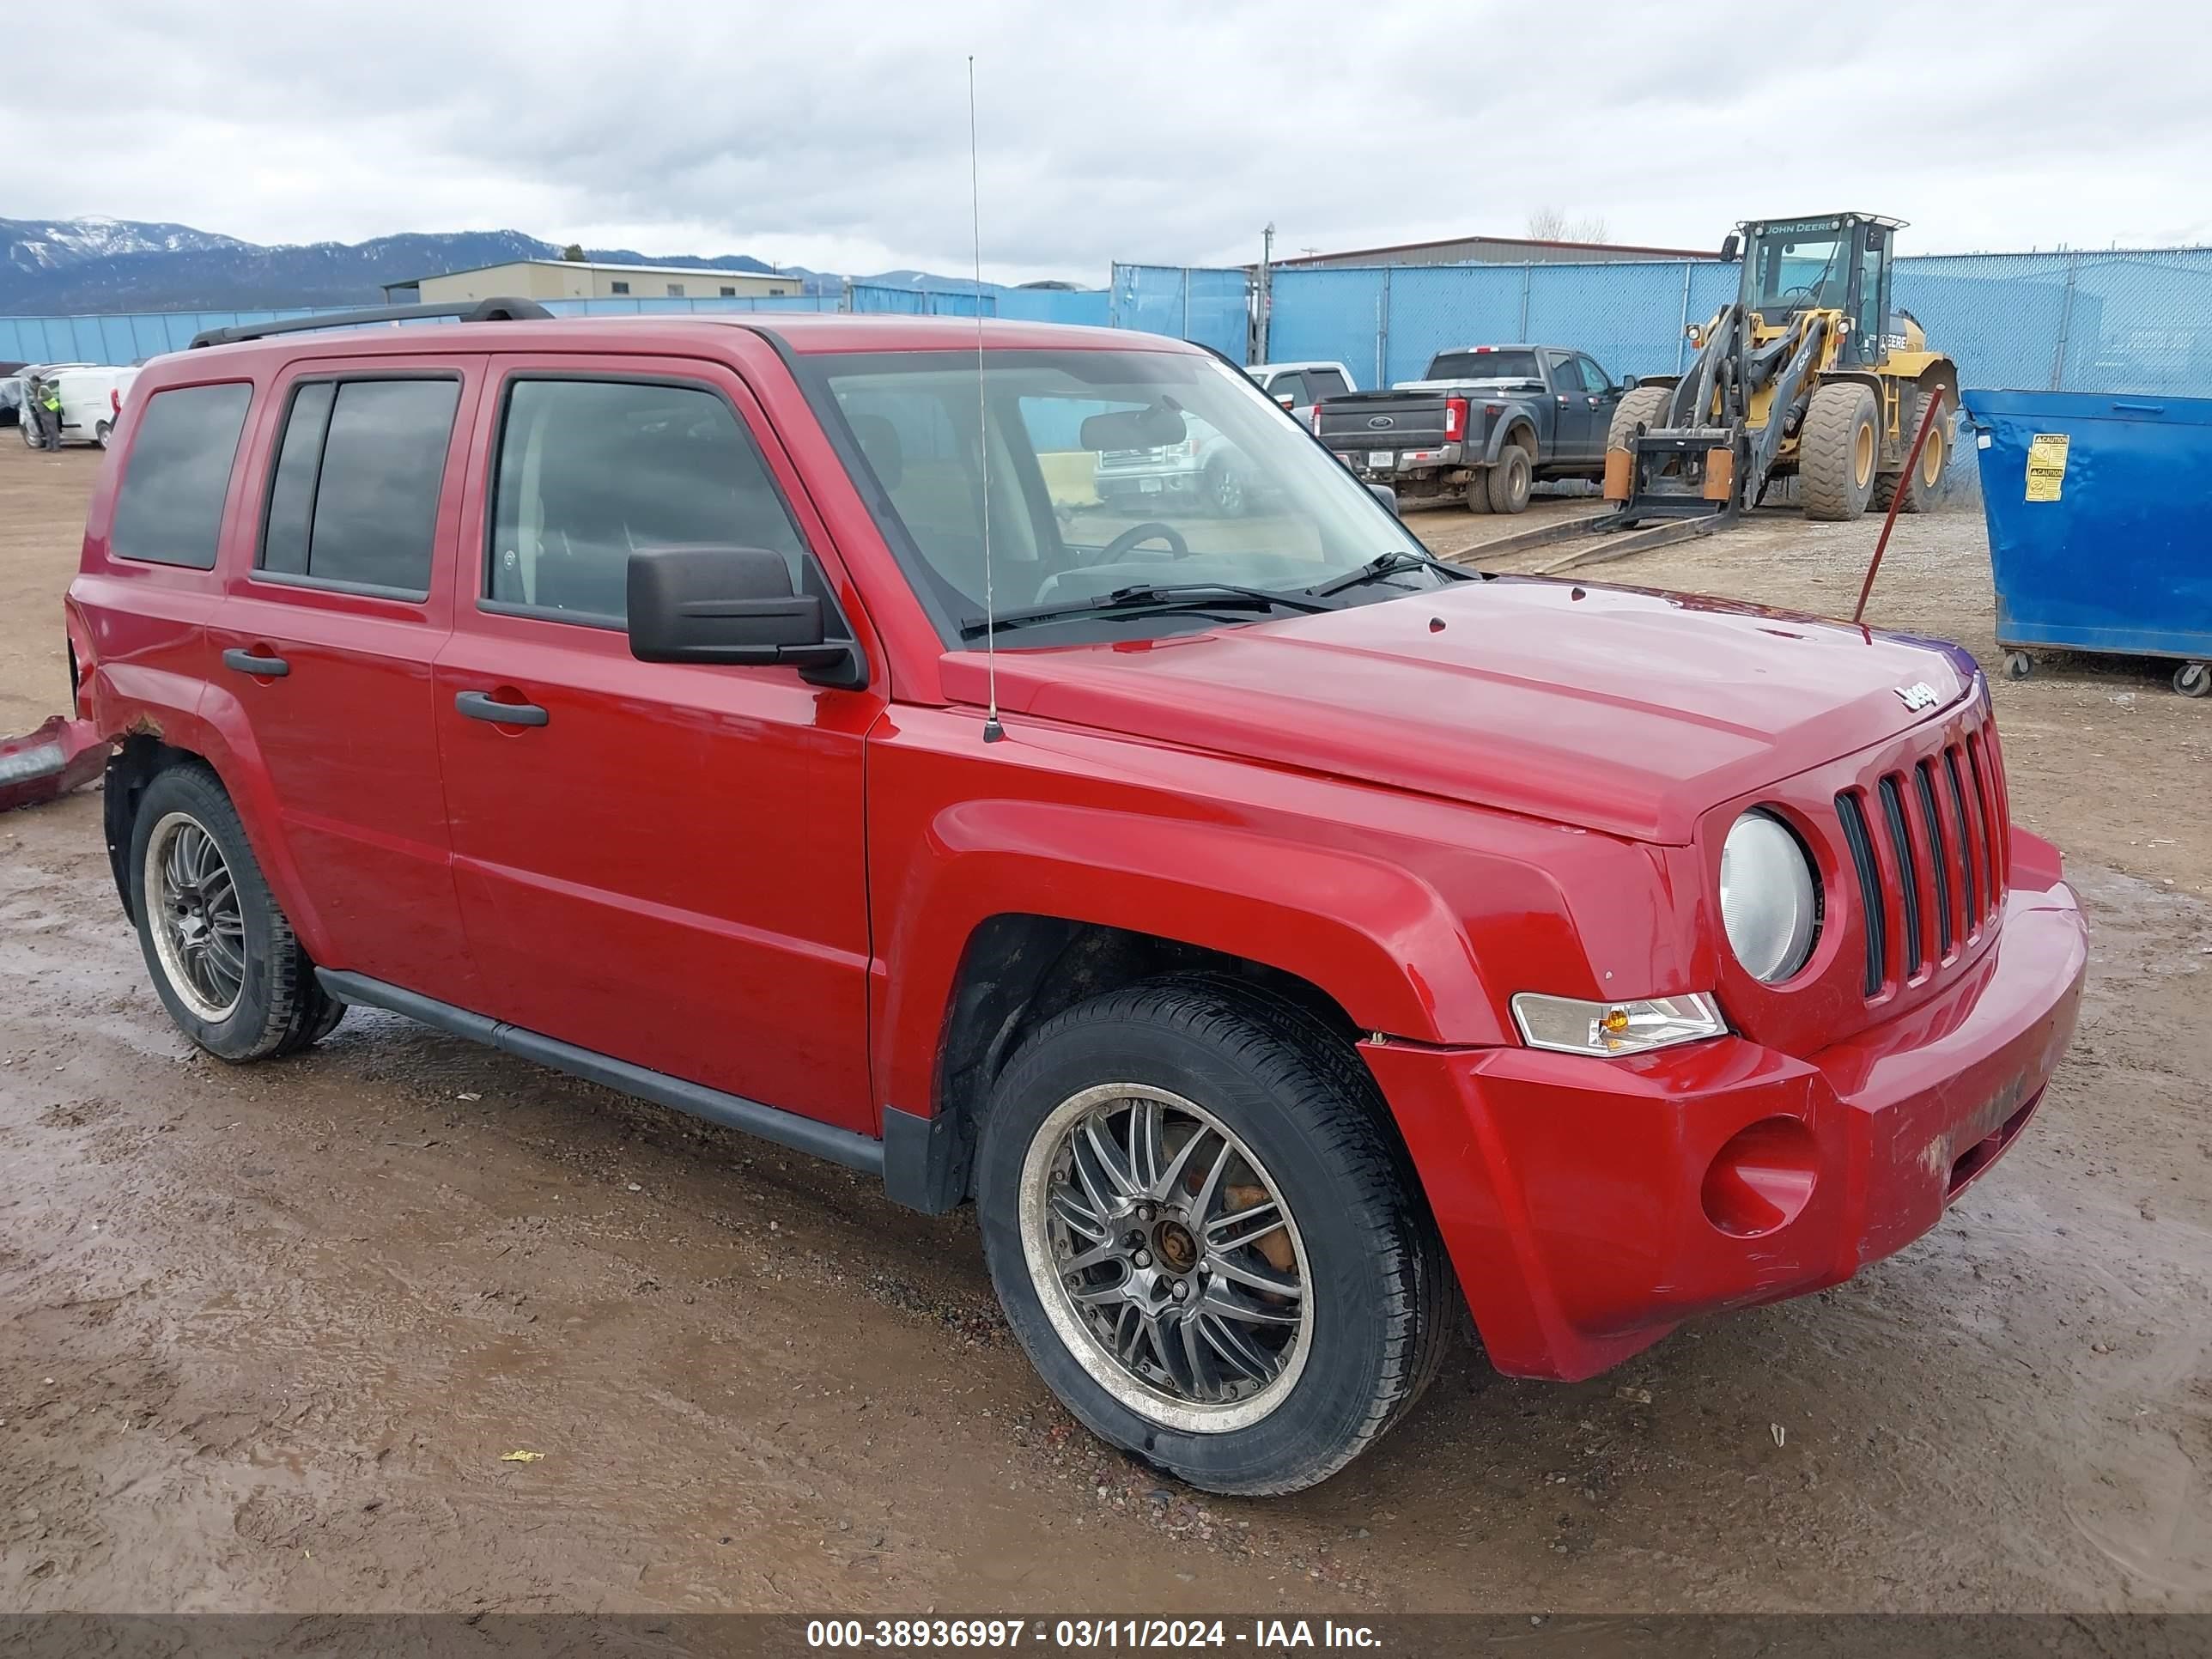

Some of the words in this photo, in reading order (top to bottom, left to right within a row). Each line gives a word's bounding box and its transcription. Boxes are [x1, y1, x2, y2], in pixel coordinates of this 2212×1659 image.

[1766, 225, 1795, 234] JOHN
[1796, 223, 1832, 233] DEERE
[1797, 343, 1811, 372] 624J
[2037, 469, 2063, 477] CAUTION
